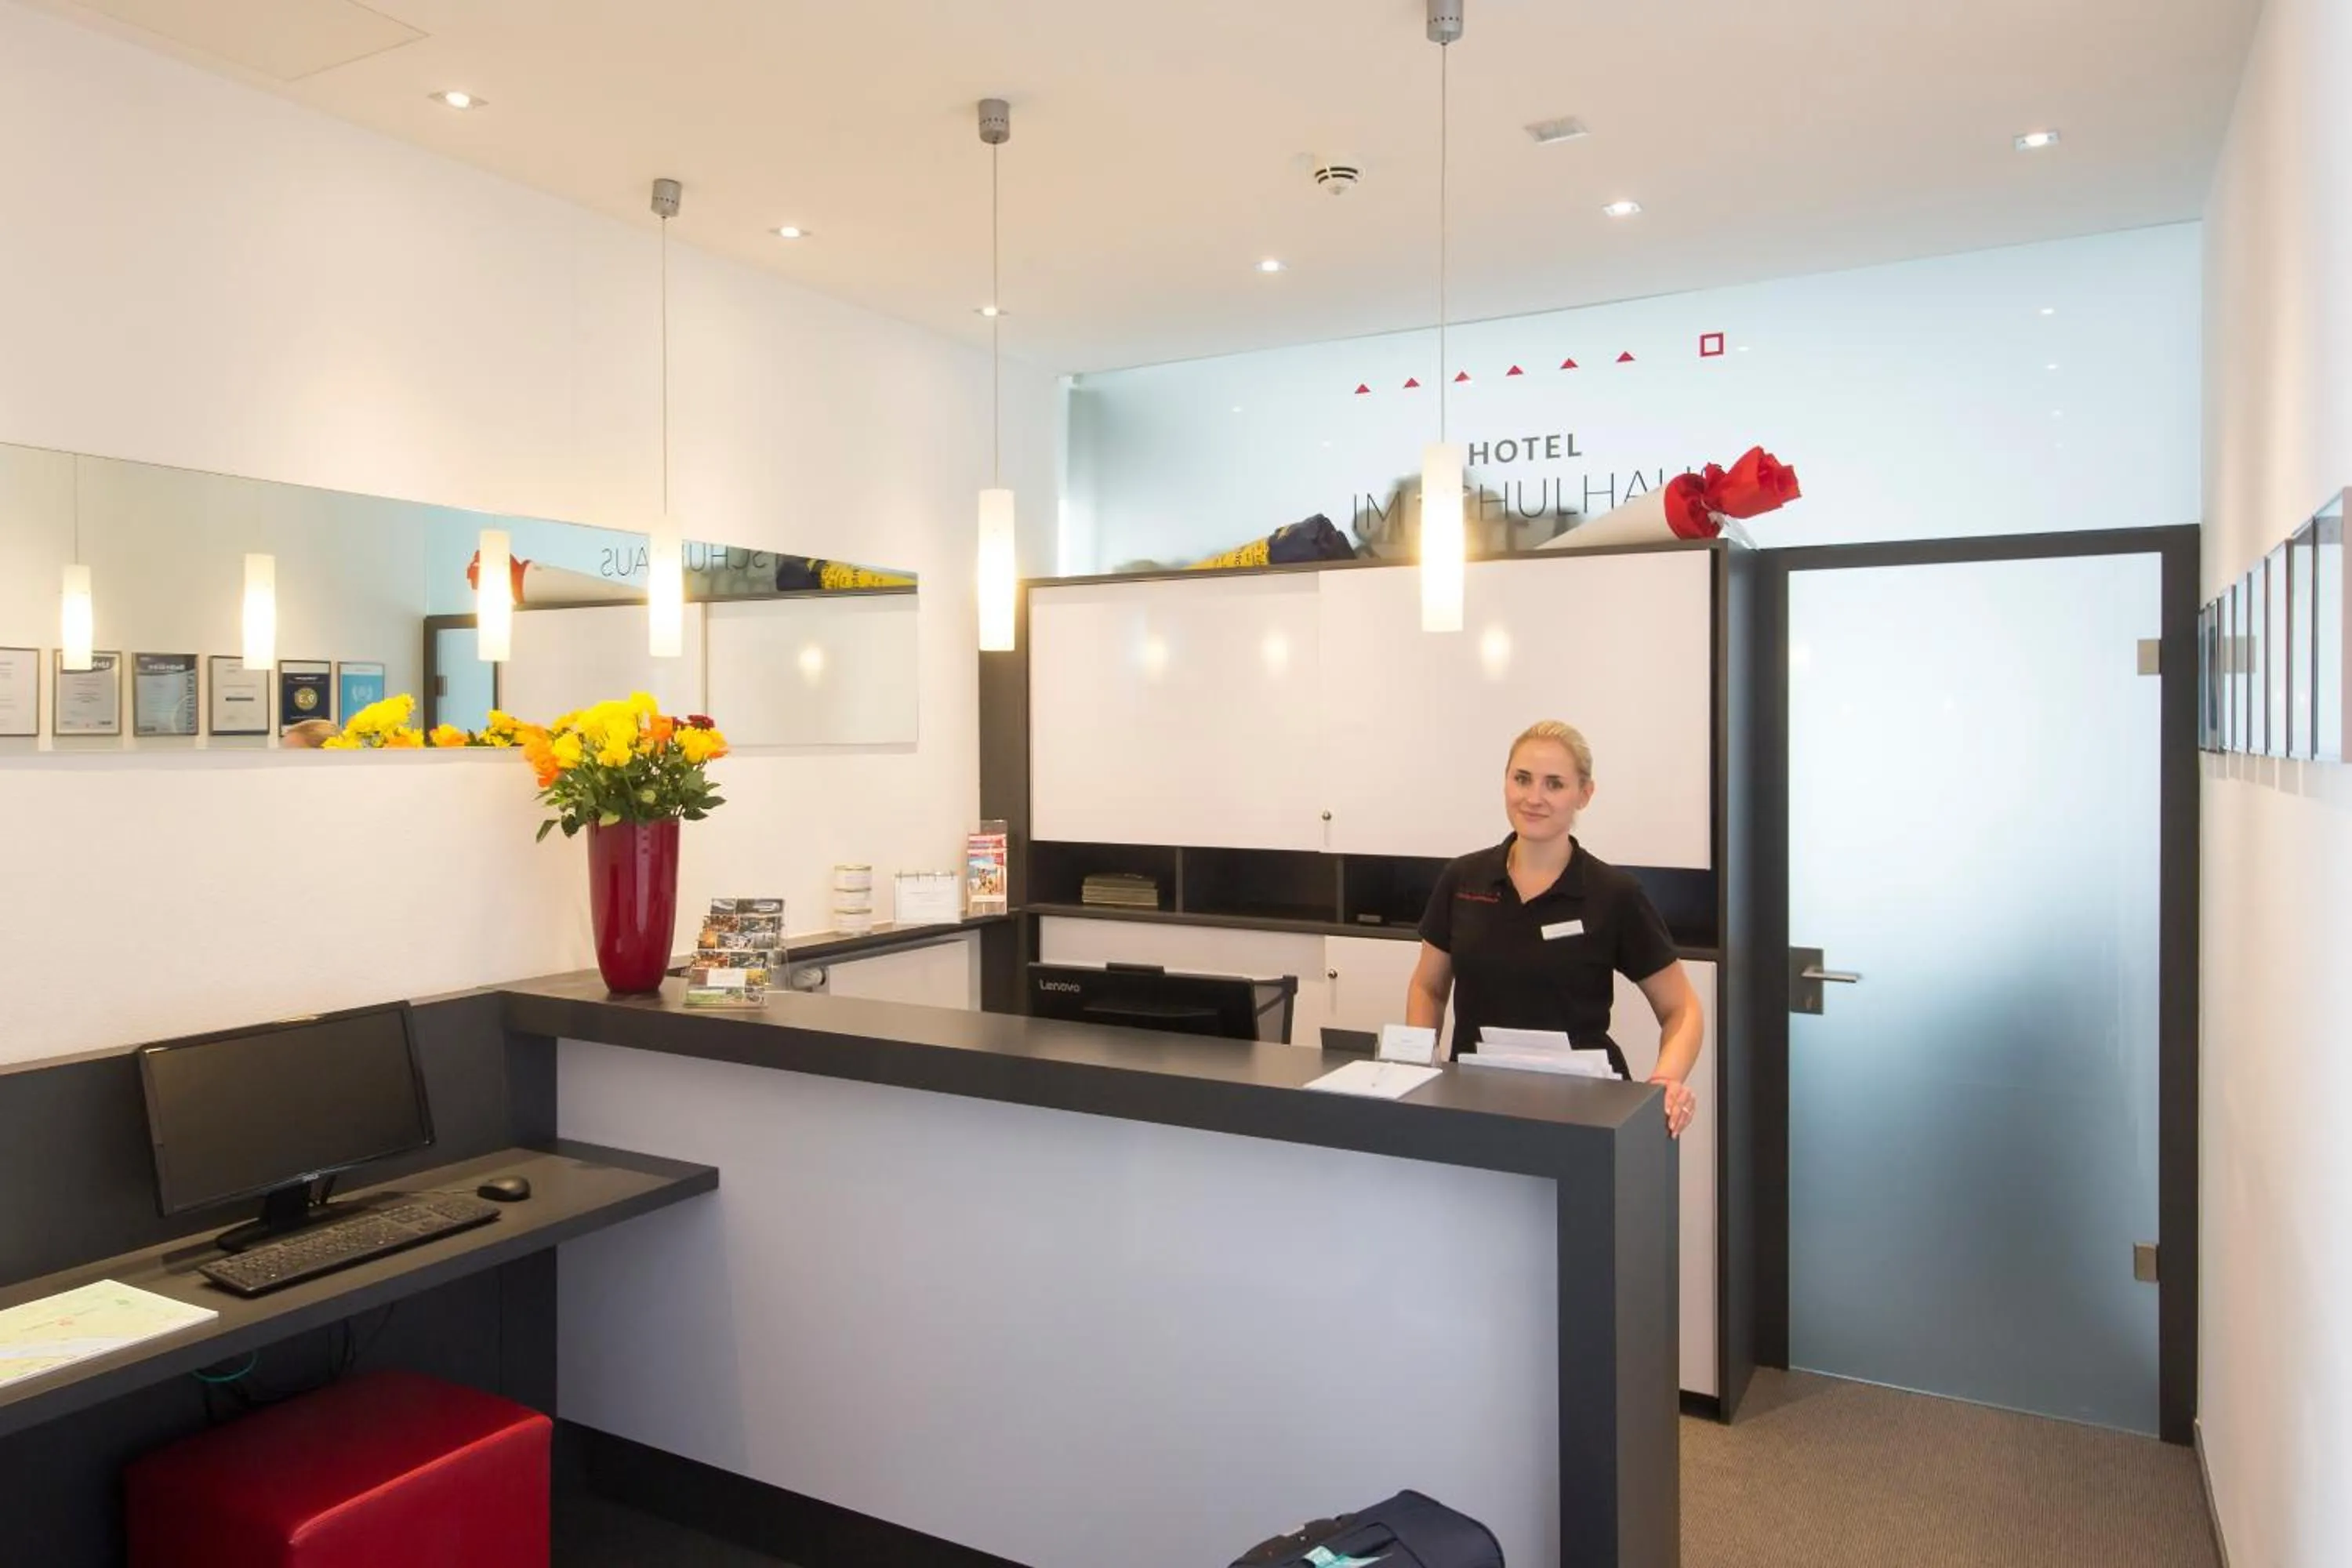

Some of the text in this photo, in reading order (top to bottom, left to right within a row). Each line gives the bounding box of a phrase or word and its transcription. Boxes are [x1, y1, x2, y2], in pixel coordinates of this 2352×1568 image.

[1468, 433, 1582, 466] HOTEL
[1354, 461, 1722, 530] IM HULHA
[1039, 978, 1080, 993] Lenovo
